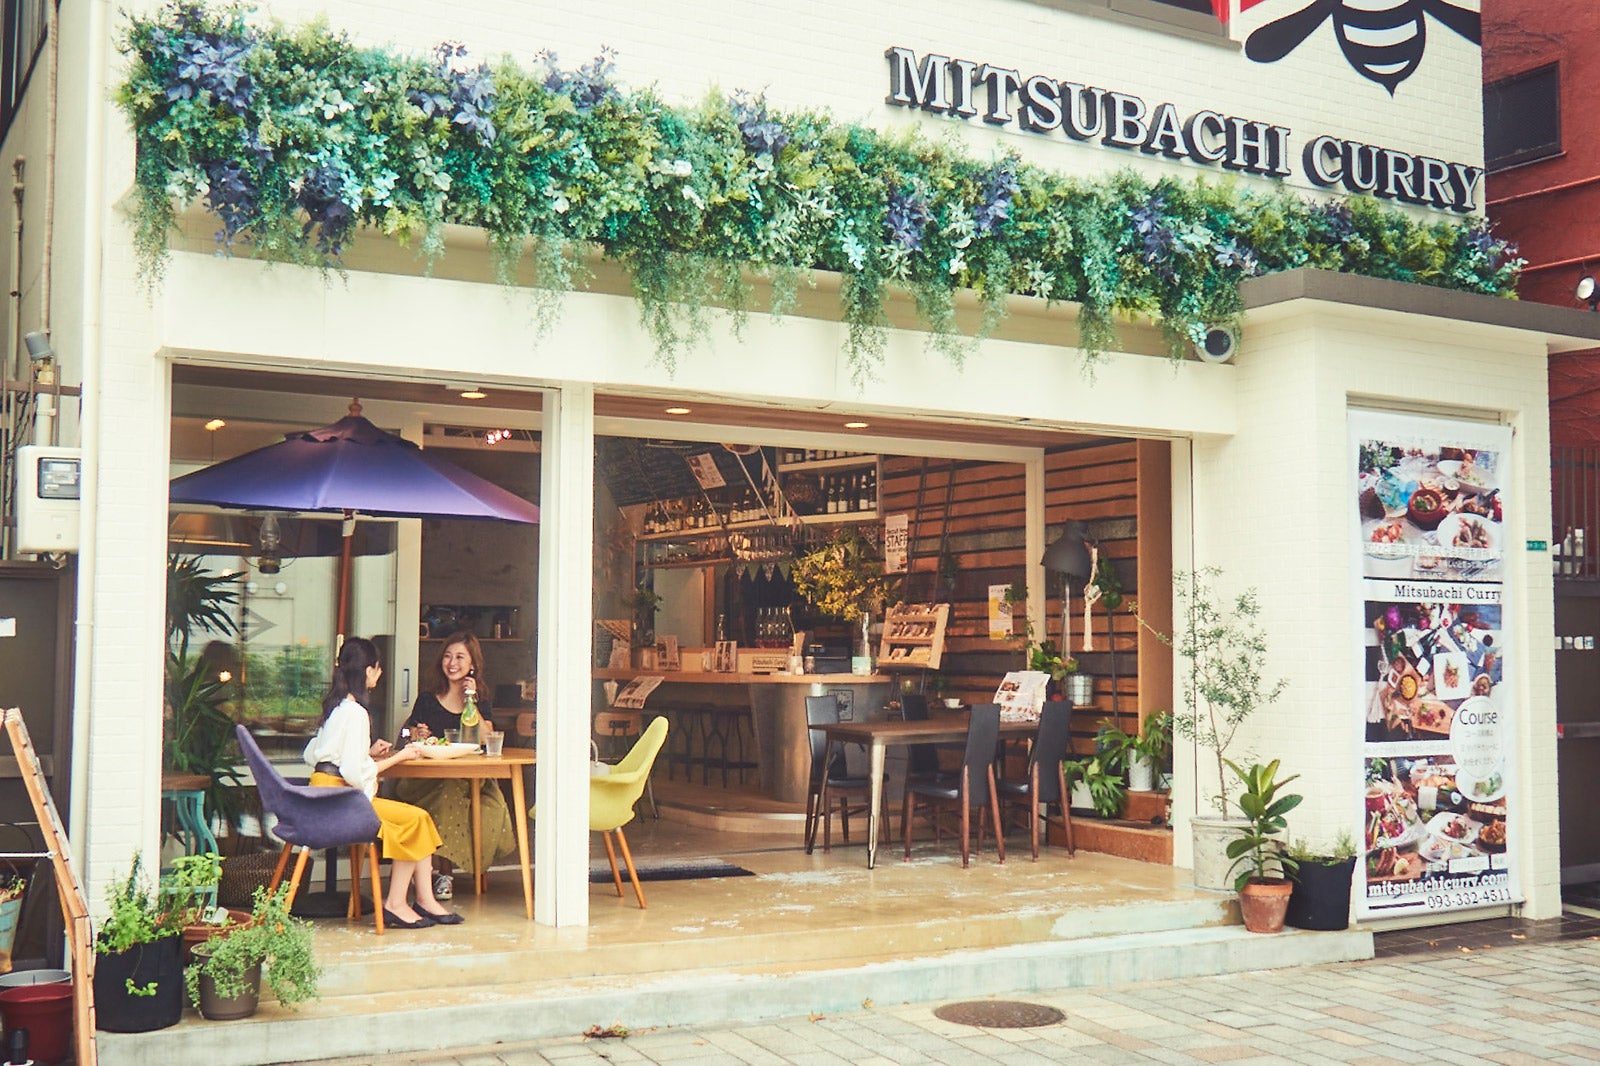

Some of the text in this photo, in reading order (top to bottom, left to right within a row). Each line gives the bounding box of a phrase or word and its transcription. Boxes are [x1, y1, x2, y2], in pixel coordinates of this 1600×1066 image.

[884, 46, 1484, 213] MITSUBACHI CURRY
[886, 534, 908, 547] STAFF
[1394, 585, 1502, 603] Mitsubachi Curry
[1459, 708, 1498, 725] Course
[1368, 873, 1508, 897] mitsubachicurry.com
[1427, 888, 1512, 909] 093-332-4511
